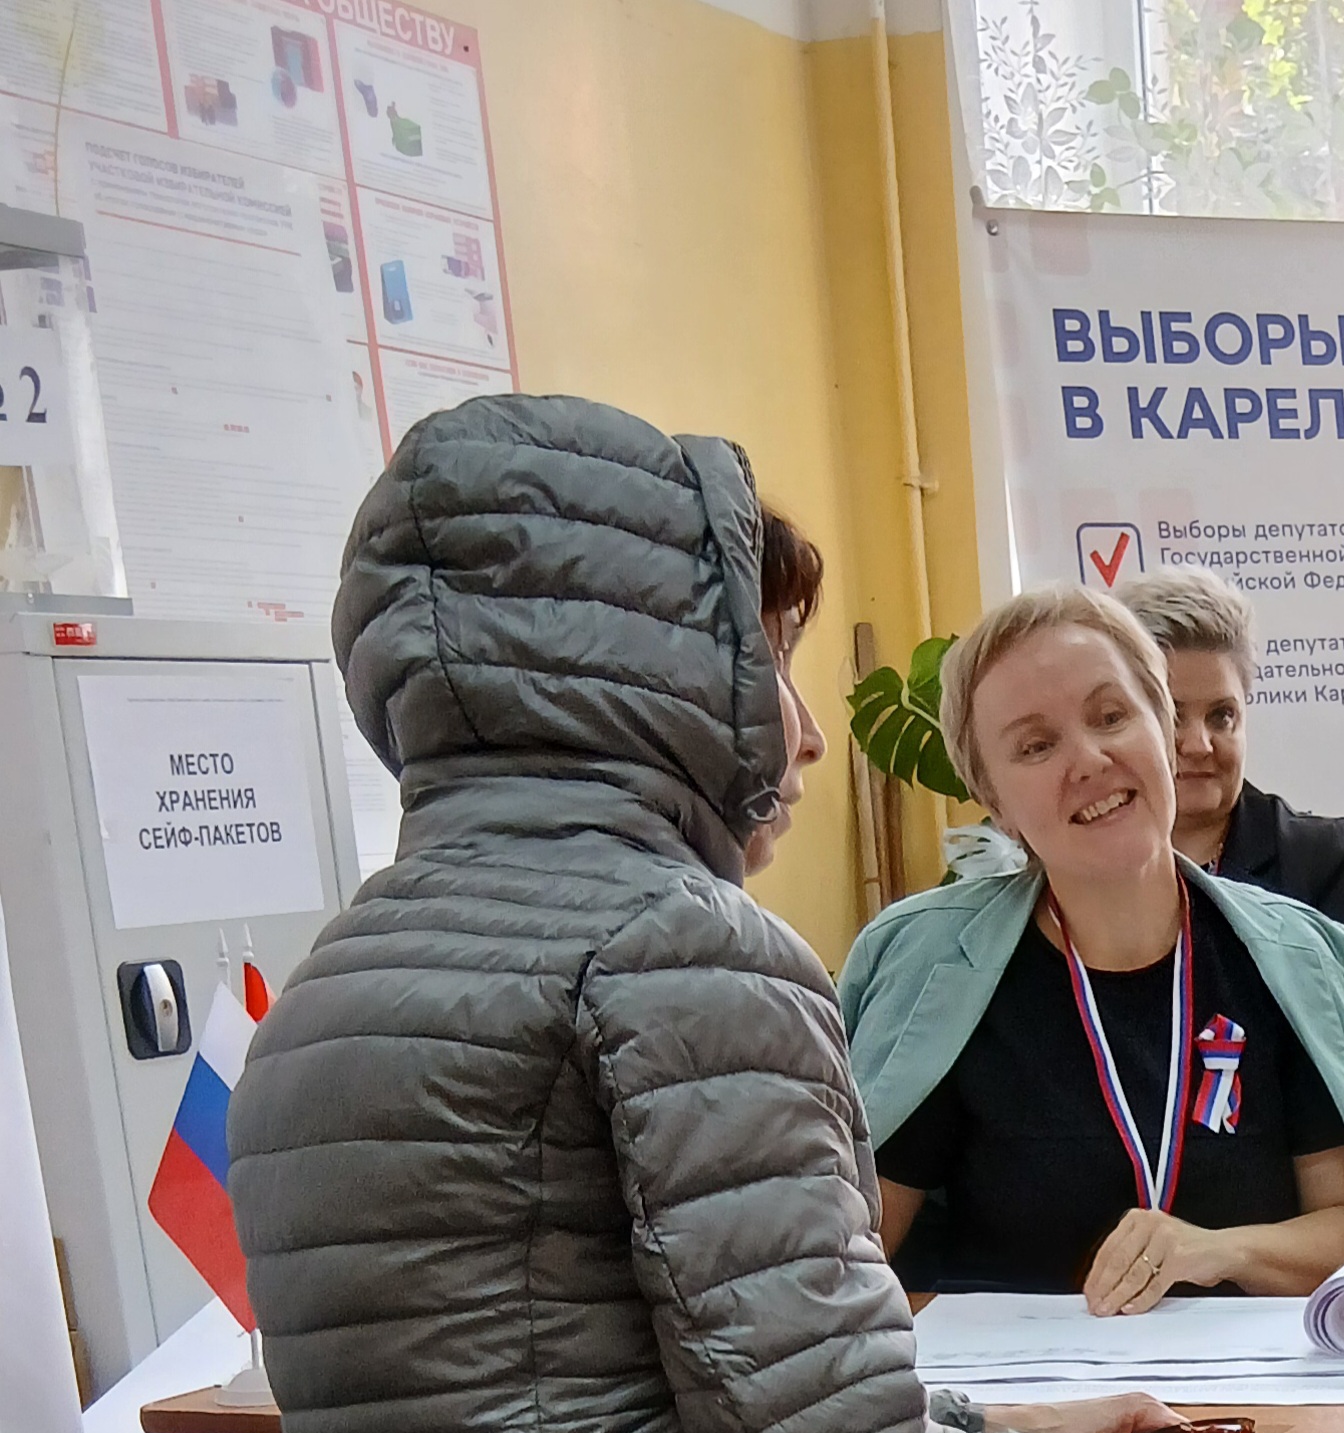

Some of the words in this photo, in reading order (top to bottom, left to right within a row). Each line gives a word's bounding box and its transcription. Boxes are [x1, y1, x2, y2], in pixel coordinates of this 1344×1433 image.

[19, 366, 47, 423] 2
[1061, 386, 1104, 439] В
[1158, 519, 1246, 542] Выборы
[1225, 569, 1296, 592] йской
[169, 752, 234, 776] МЕСТО
[156, 787, 257, 813] ХРАНЕНИЯ
[138, 821, 283, 850] СЕЙФ-ПАКЕТОВ
